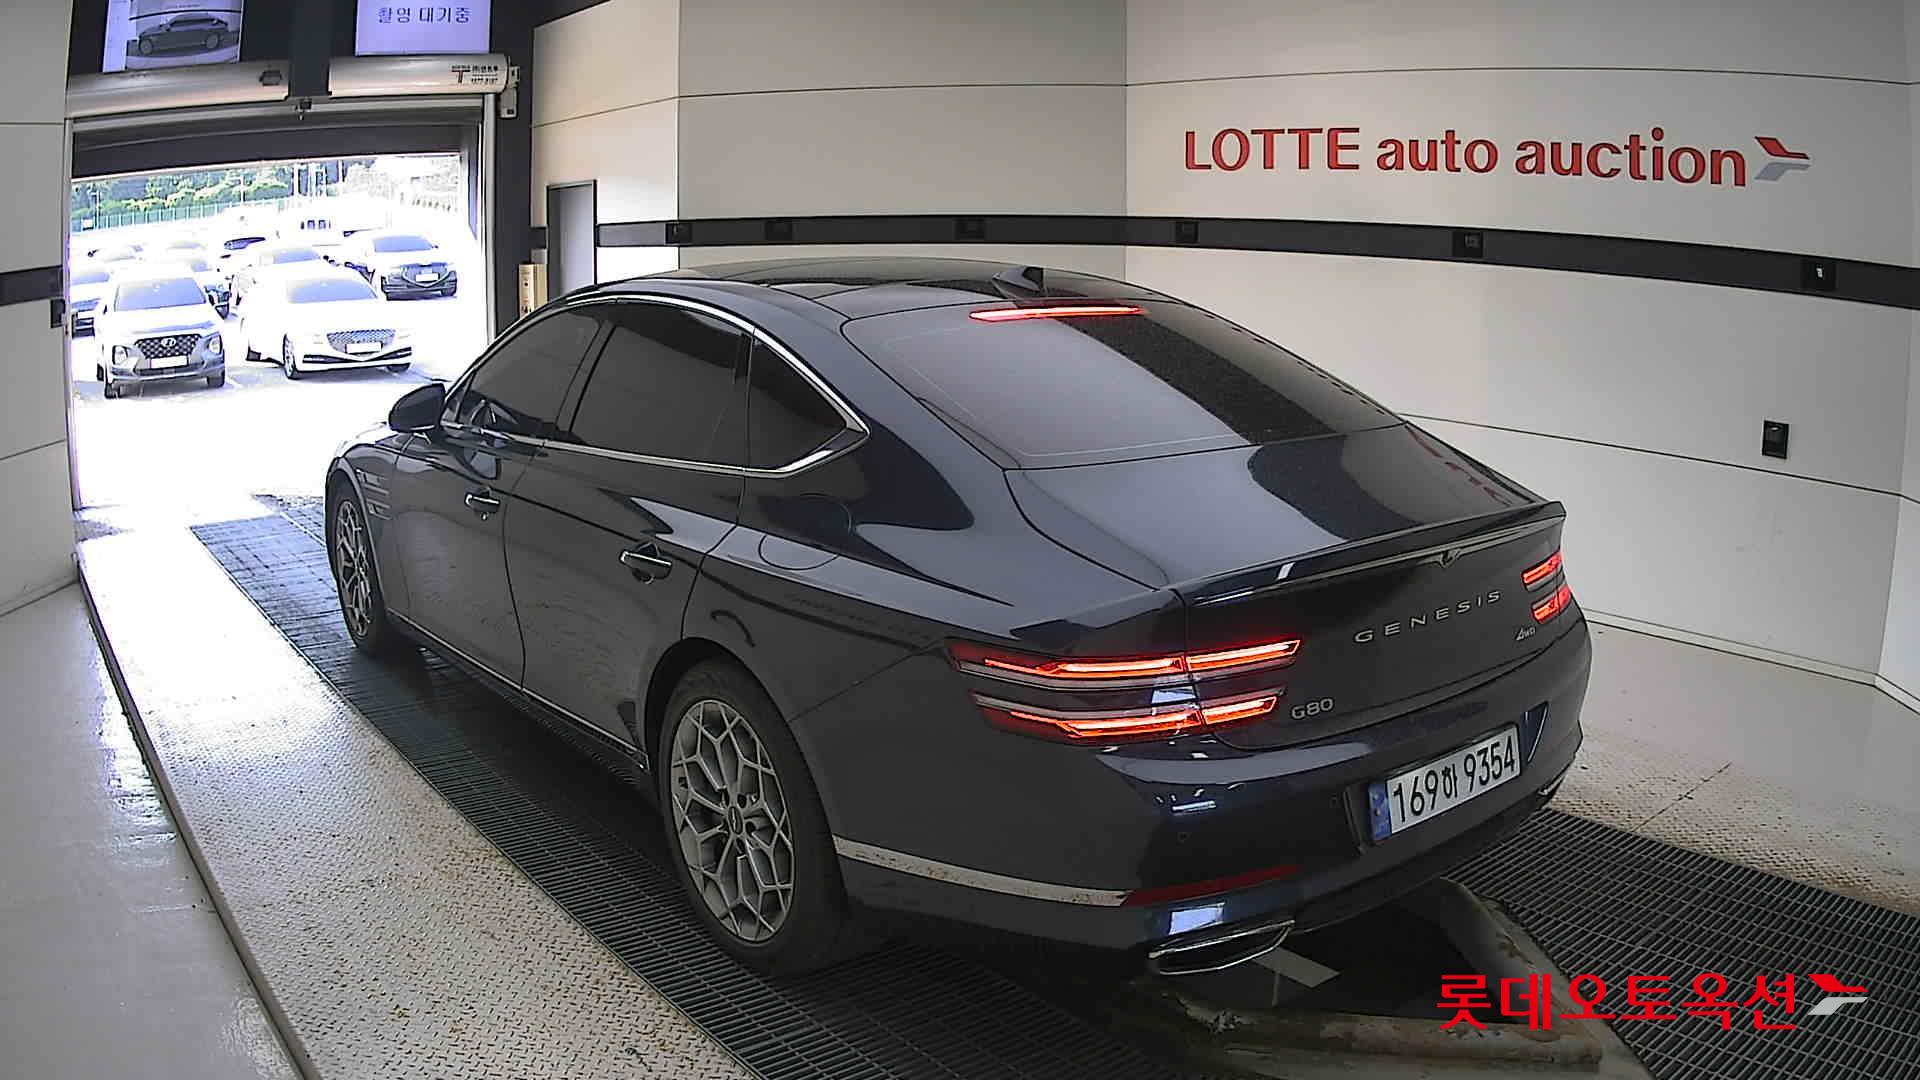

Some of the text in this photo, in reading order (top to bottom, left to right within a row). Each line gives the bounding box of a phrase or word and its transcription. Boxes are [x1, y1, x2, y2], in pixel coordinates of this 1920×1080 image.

[420, 7, 471, 23] 대기중
[1185, 127, 1746, 187] LOTTE auto auction
[1354, 590, 1500, 642] GENESIS
[1292, 699, 1333, 719] G80
[1463, 736, 1516, 793] 9354
